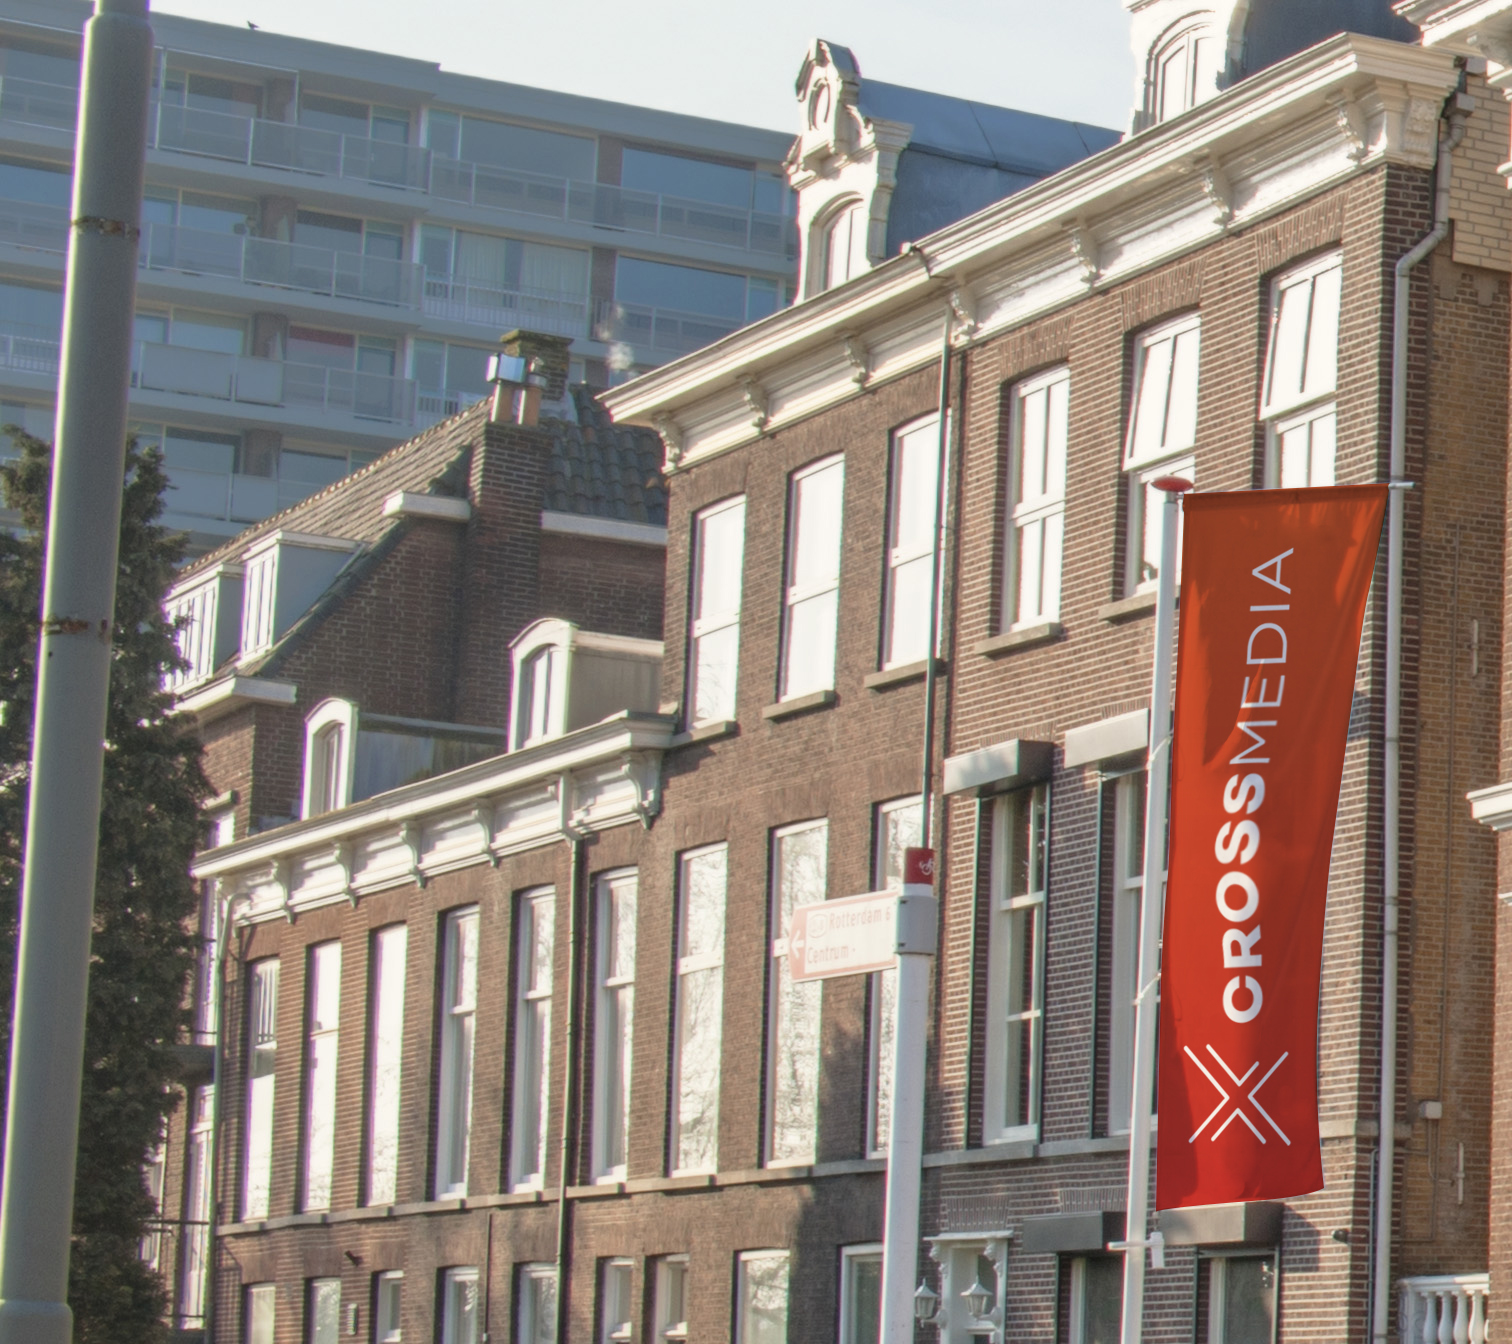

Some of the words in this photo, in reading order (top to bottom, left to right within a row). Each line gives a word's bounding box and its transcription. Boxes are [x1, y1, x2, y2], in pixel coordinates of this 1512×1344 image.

[1214, 547, 1295, 1025] CROSSMEDIA
[829, 907, 882, 929] Rotterdam
[807, 946, 849, 964] Centrum
